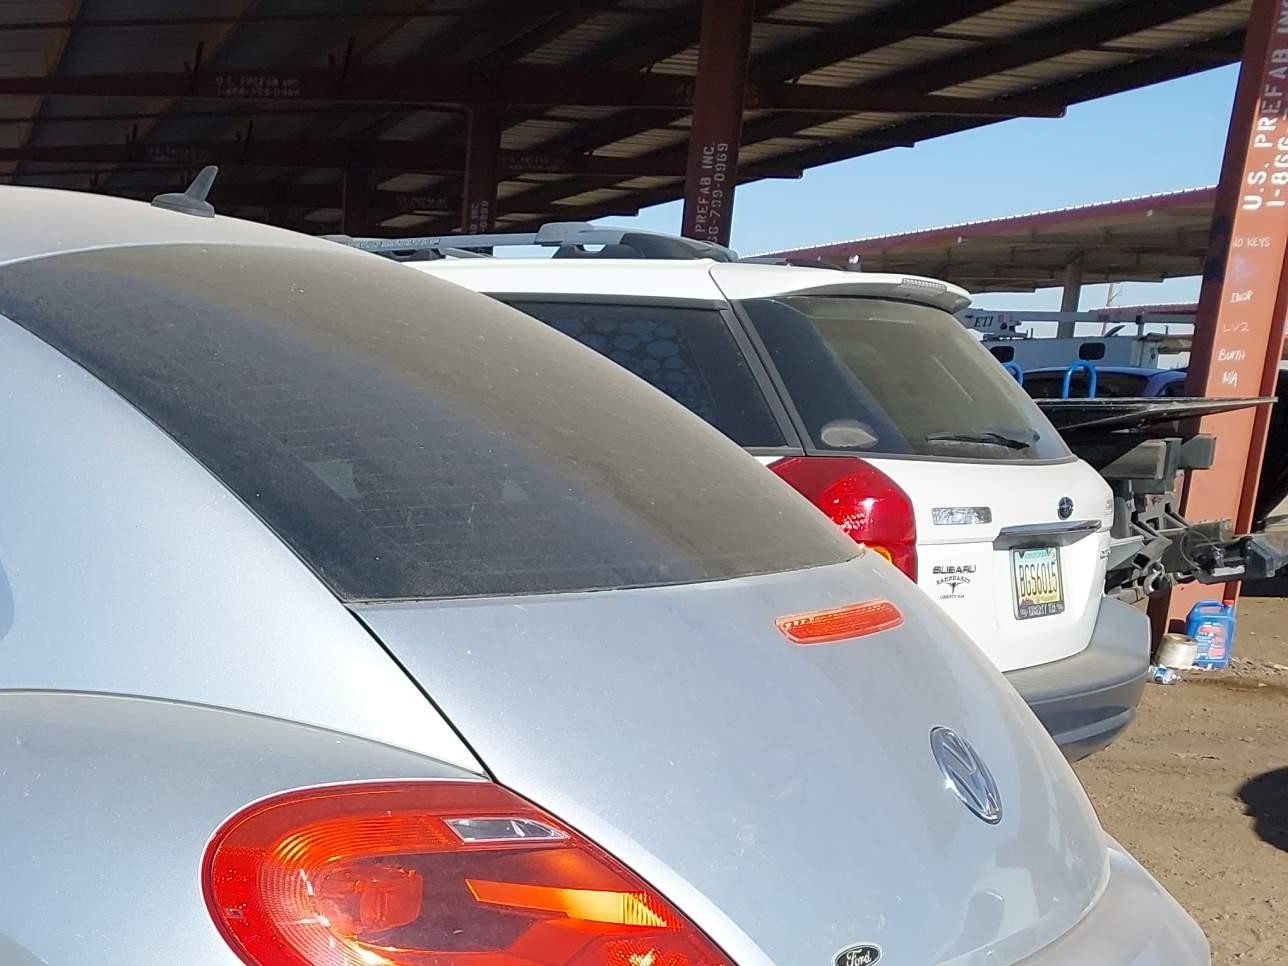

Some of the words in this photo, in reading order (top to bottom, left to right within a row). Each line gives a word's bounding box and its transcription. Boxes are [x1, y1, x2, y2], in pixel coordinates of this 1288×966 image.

[1254, 49, 1288, 148] PREFAB
[695, 176, 712, 233] PREFAB
[1243, 163, 1270, 210] U.S.
[1247, 236, 1272, 248] KEYS
[932, 564, 977, 575] SUBARU
[1018, 561, 1058, 597] BGS6015
